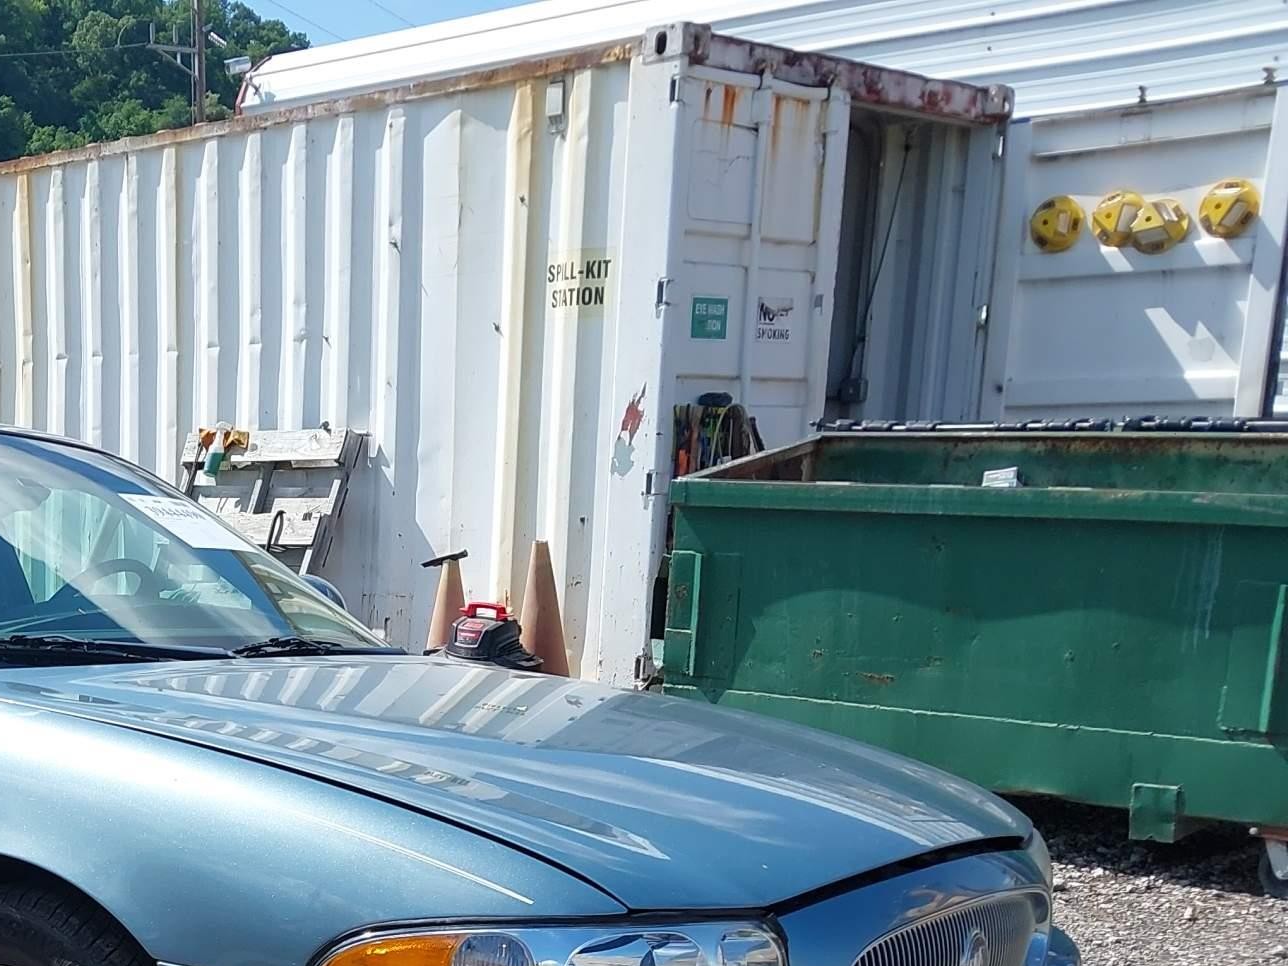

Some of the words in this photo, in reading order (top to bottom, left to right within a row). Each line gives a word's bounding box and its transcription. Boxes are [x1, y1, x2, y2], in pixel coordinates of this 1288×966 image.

[547, 259, 612, 283] SPILL-KIT
[551, 286, 605, 308] STATION
[757, 328, 790, 341] SMOKING
